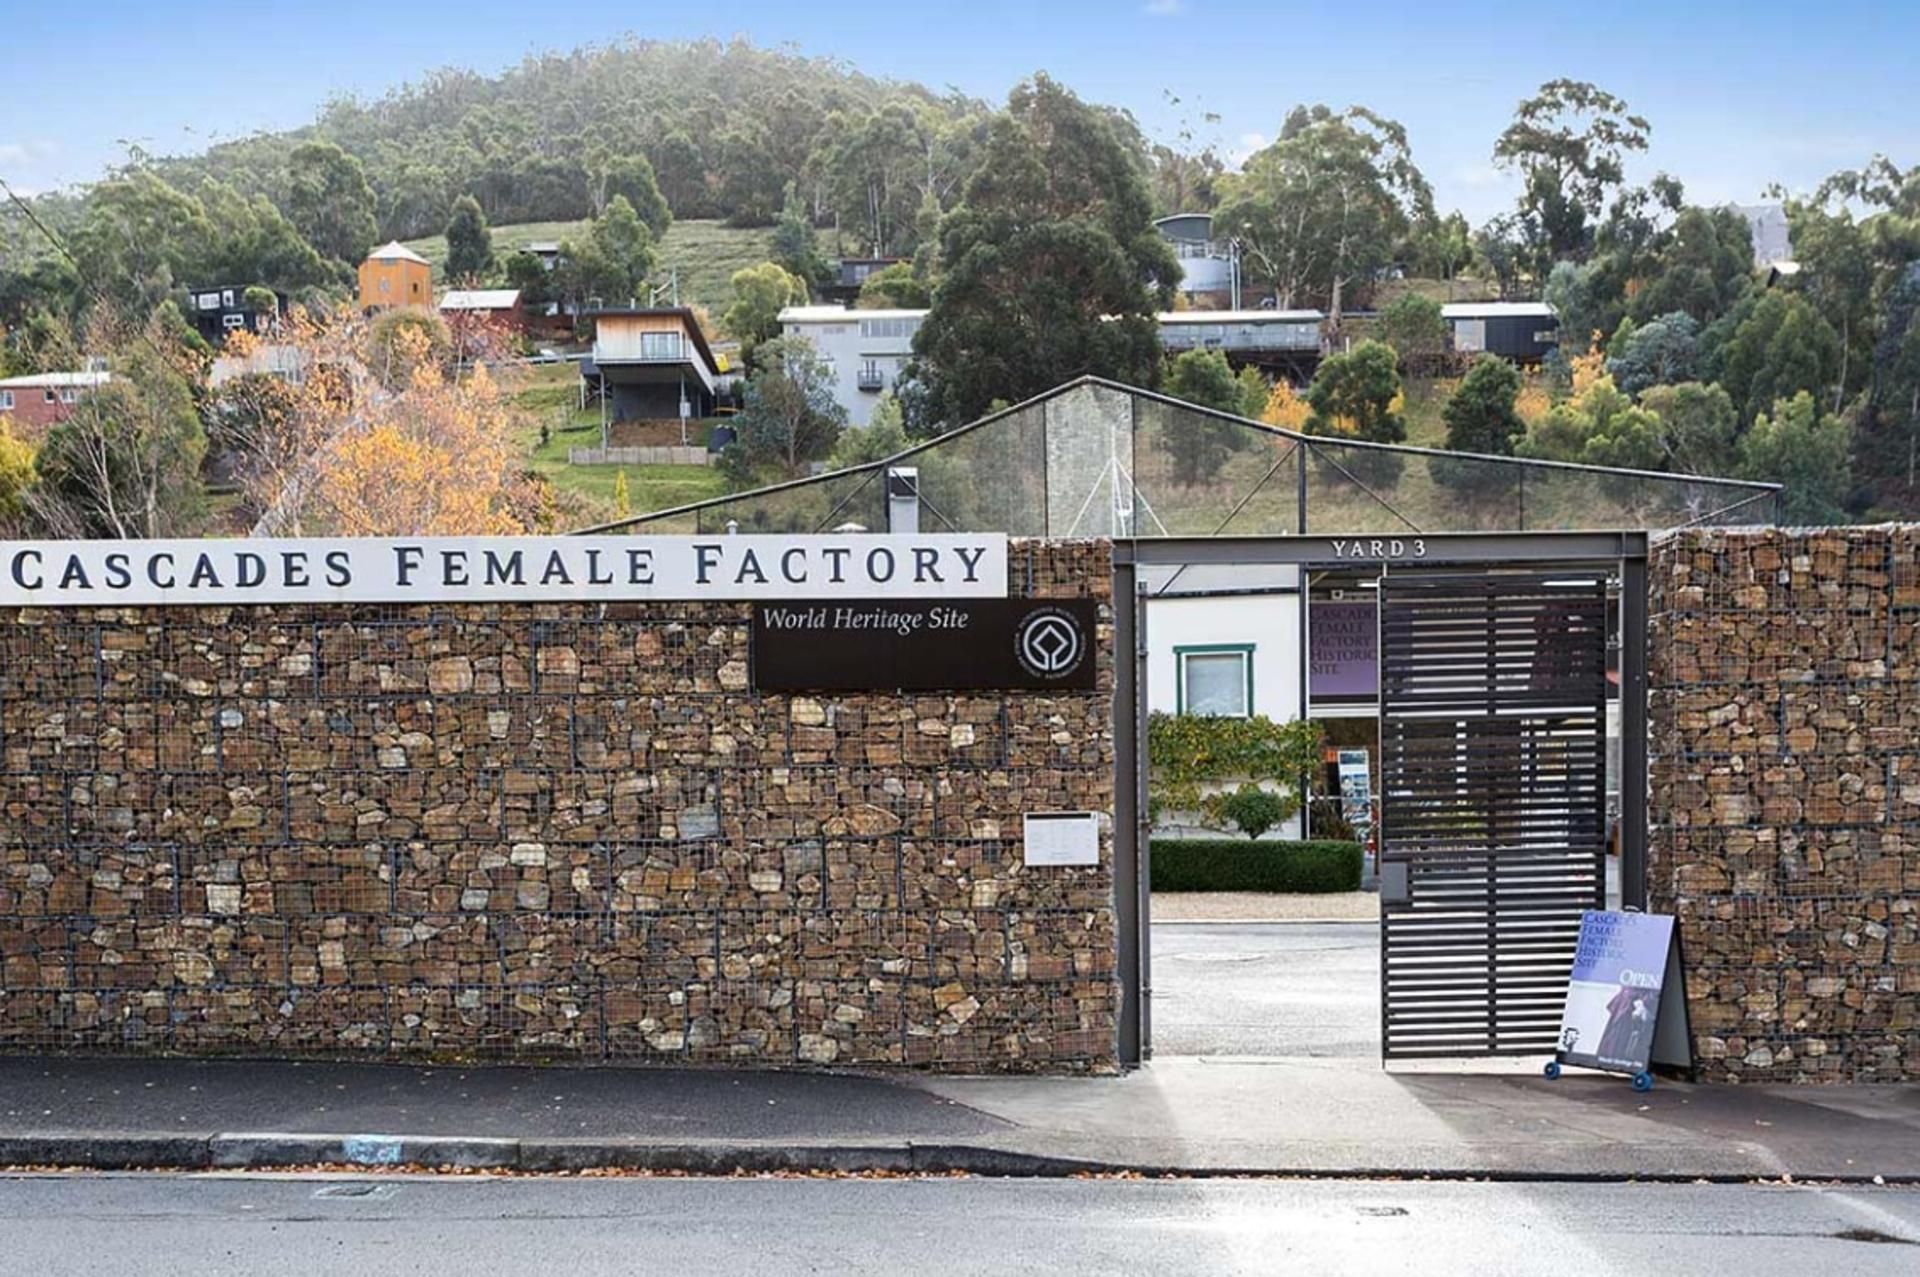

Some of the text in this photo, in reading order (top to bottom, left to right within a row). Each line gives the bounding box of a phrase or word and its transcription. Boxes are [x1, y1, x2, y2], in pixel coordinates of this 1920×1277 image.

[1332, 539, 1426, 558] YARD 3
[11, 544, 987, 590] CASCADES FEMALE FACTORY
[764, 606, 969, 636] World Heritage Site
[1619, 968, 1660, 988] OPEN
